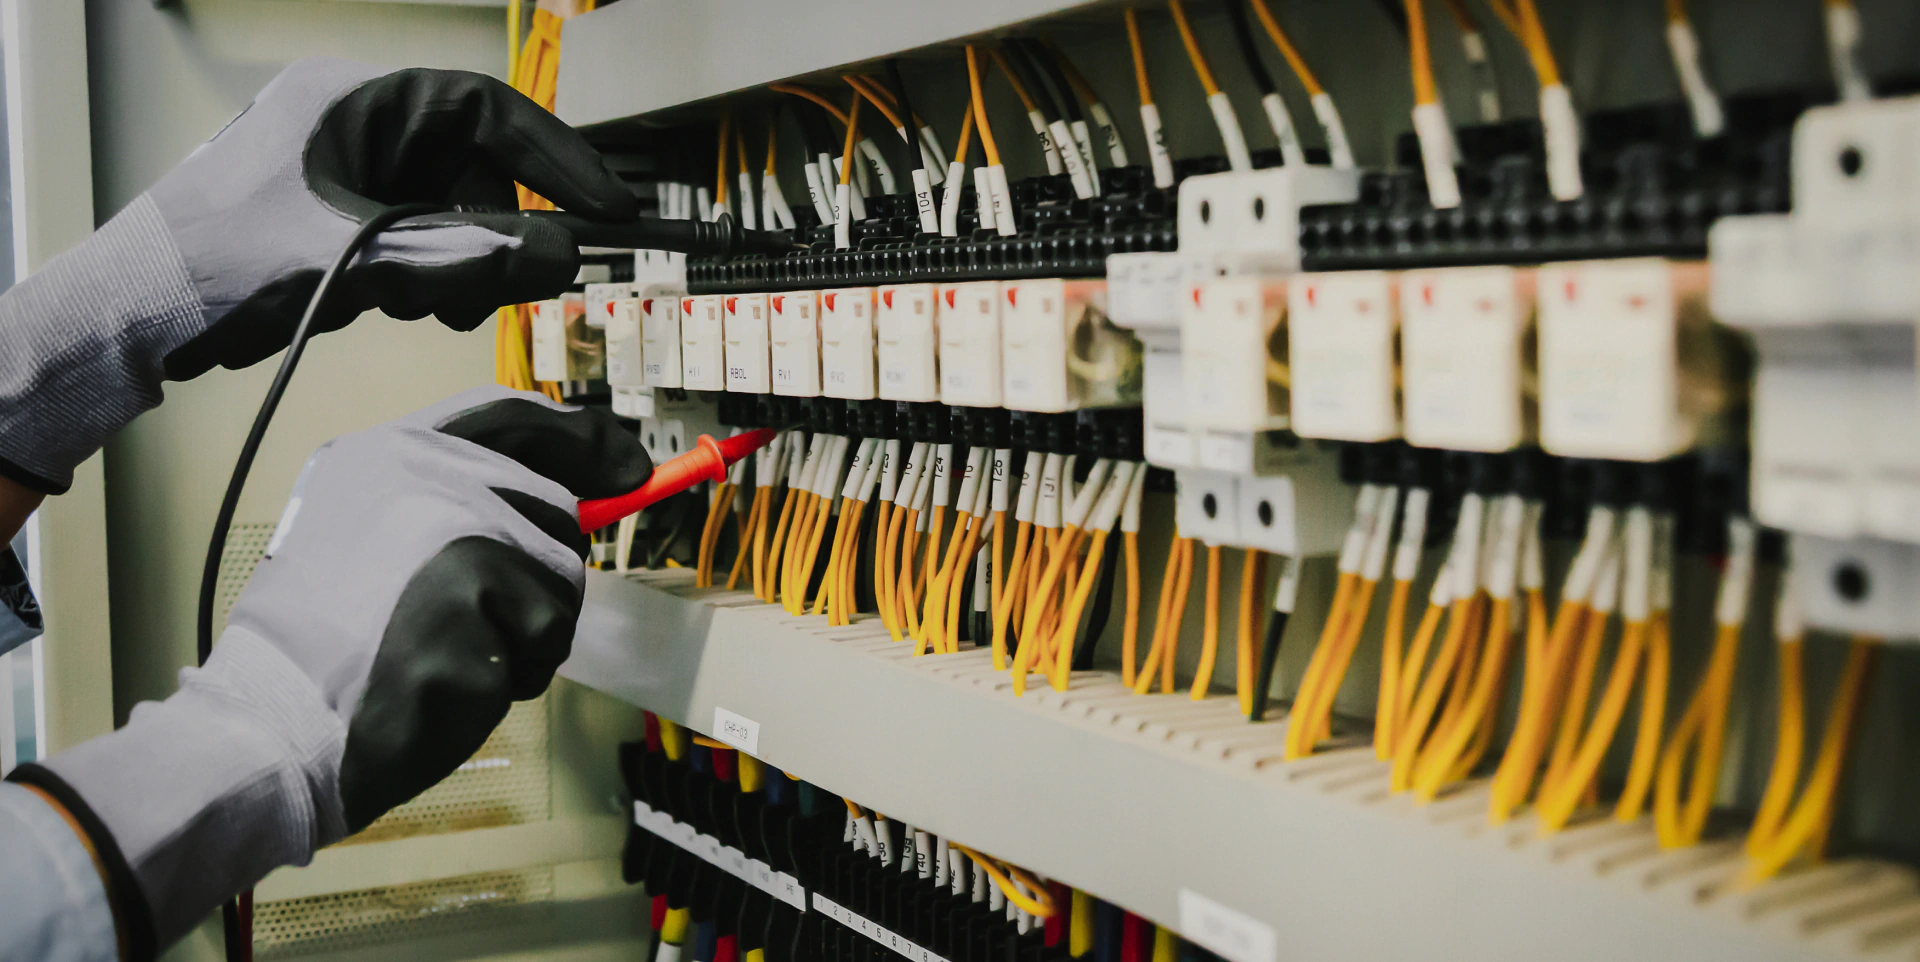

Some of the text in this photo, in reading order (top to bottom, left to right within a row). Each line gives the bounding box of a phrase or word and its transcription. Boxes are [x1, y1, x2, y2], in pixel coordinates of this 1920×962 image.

[917, 191, 932, 215] 104
[934, 456, 944, 479] 124
[918, 852, 927, 874] 140
[833, 905, 838, 916] 2
[847, 912, 852, 923] 3
[861, 920, 866, 930] 4
[907, 943, 912, 954] 7
